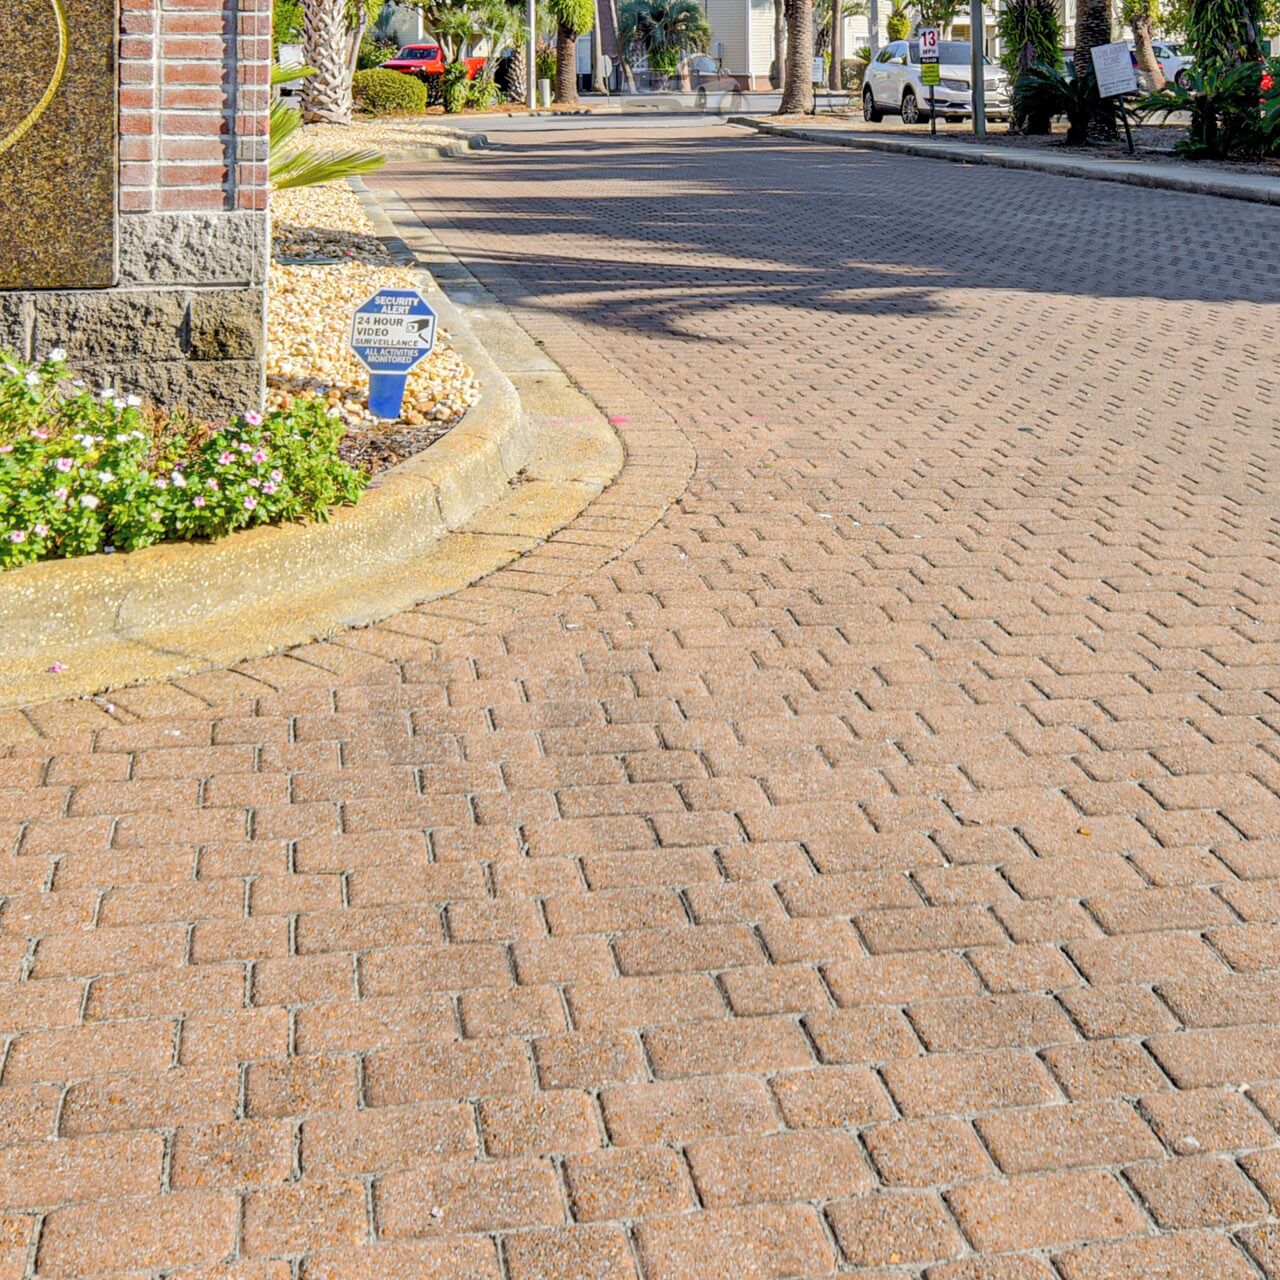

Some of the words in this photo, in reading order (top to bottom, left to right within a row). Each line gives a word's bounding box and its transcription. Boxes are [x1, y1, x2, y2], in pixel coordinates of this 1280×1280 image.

[921, 31, 936, 46] 13
[374, 296, 419, 307] SECURITY
[381, 306, 410, 315] ALERT
[357, 317, 370, 326] 24
[373, 318, 404, 327] HOUR
[357, 328, 389, 337] VIDEO
[355, 338, 419, 347] SURVEILLANCE
[364, 348, 380, 356] ALL
[380, 349, 419, 357] ACTIVITIES
